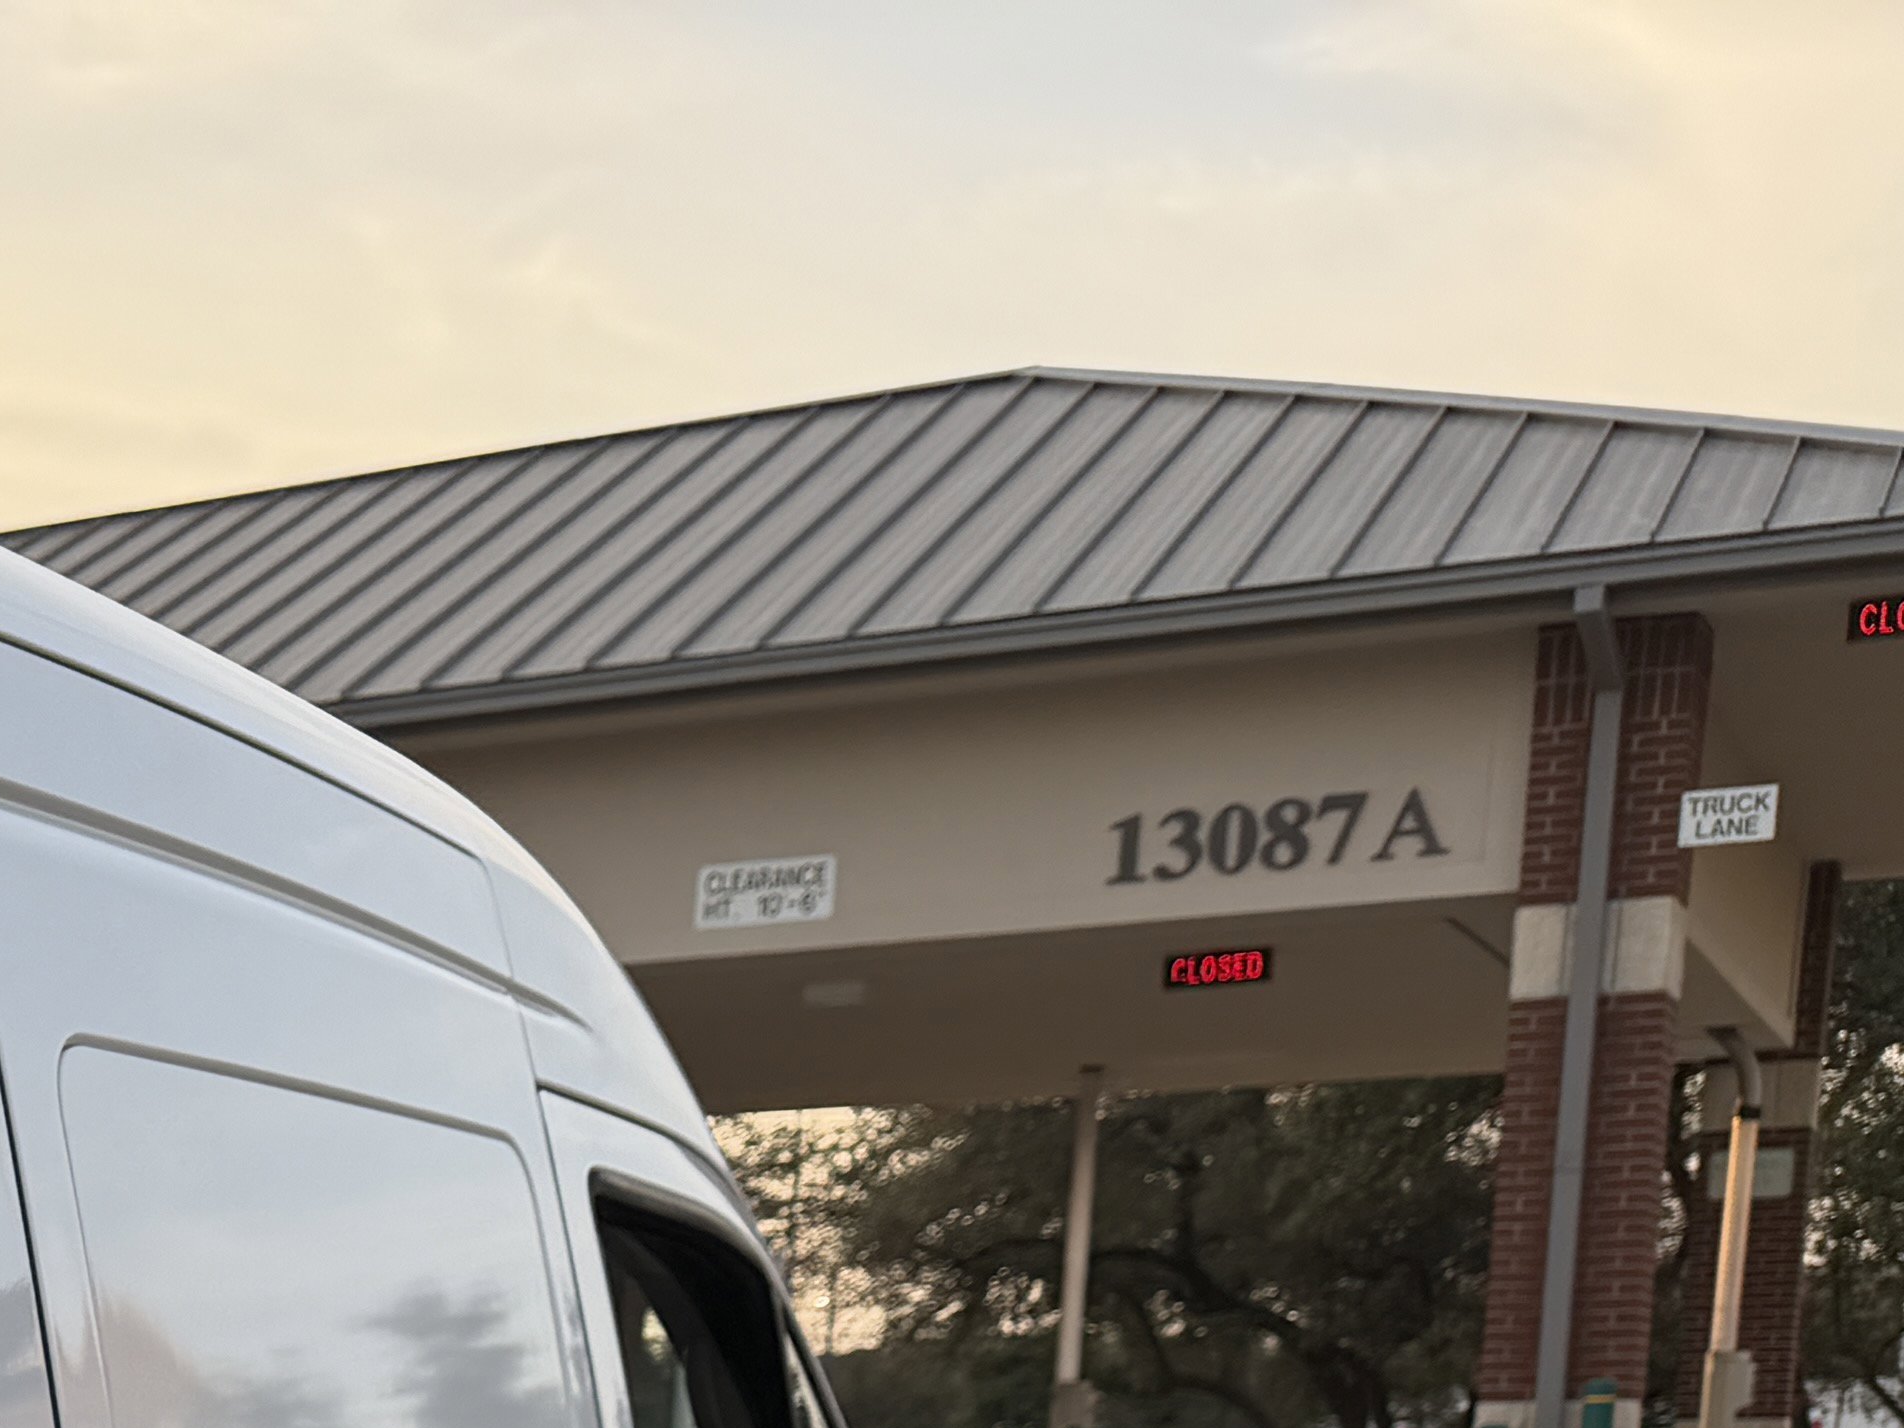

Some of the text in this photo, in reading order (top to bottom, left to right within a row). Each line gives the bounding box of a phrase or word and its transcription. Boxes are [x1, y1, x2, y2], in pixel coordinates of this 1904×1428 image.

[1688, 792, 1771, 817] TRUCK
[1694, 815, 1759, 839] LANE
[703, 860, 828, 895] CLEARANCE
[1169, 951, 1264, 985] CLOSED
